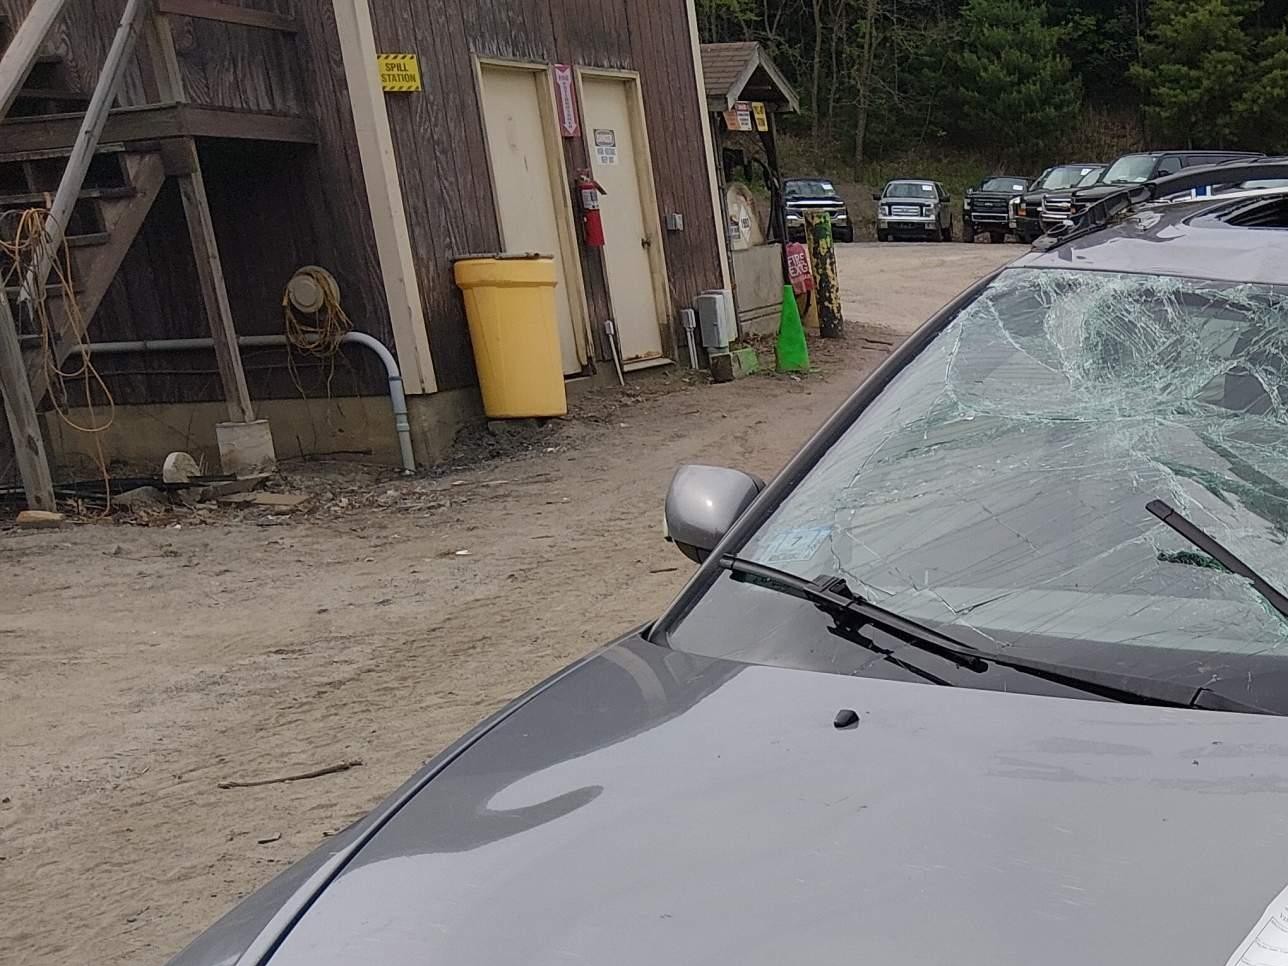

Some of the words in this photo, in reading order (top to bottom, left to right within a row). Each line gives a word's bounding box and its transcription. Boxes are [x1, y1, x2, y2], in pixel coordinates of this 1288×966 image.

[385, 63, 408, 72] SPILL
[381, 73, 417, 83] STATION
[787, 253, 805, 267] FIRE
